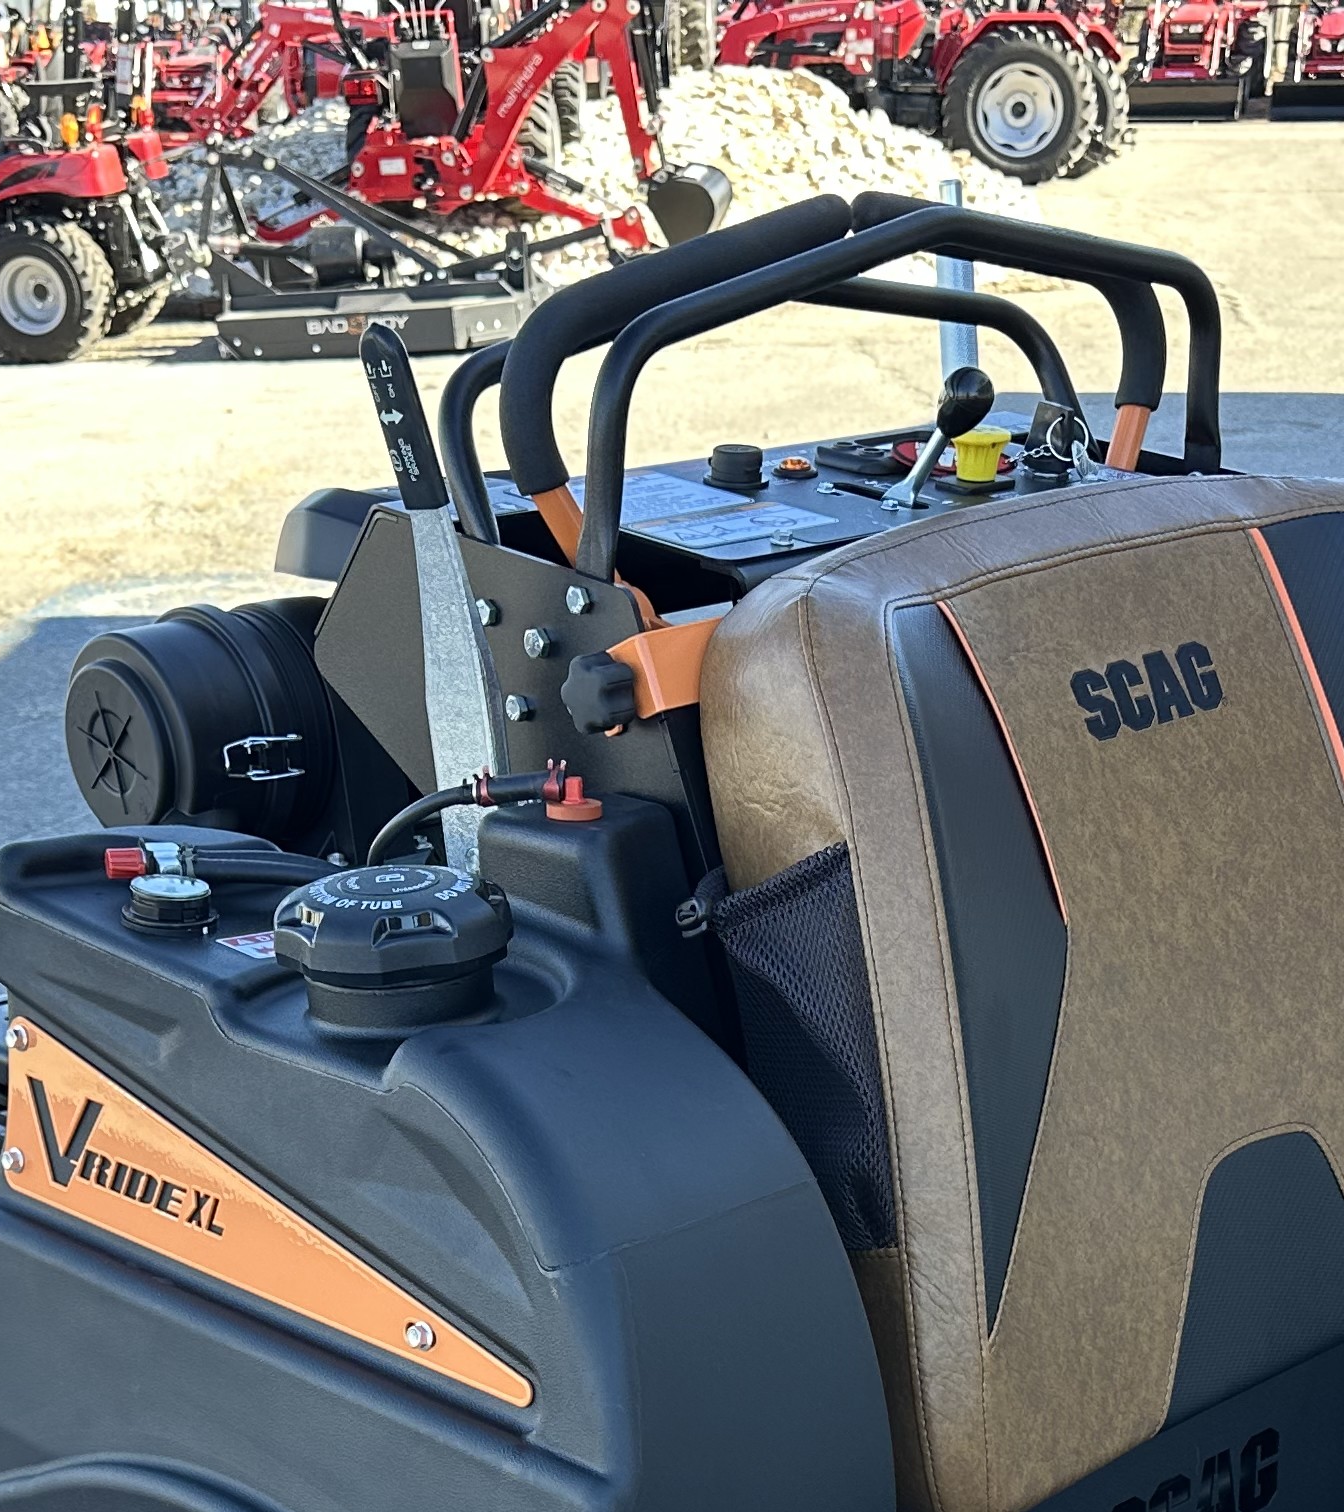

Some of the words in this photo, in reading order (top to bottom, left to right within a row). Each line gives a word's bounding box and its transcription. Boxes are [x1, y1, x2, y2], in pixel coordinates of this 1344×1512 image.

[496, 53, 543, 118] mahindra
[306, 317, 348, 335] BAD
[387, 383, 396, 398] ON
[1070, 641, 1223, 741] SCAG
[335, 900, 358, 909] OF
[360, 899, 403, 910] TUBE
[185, 1188, 225, 1238] XL
